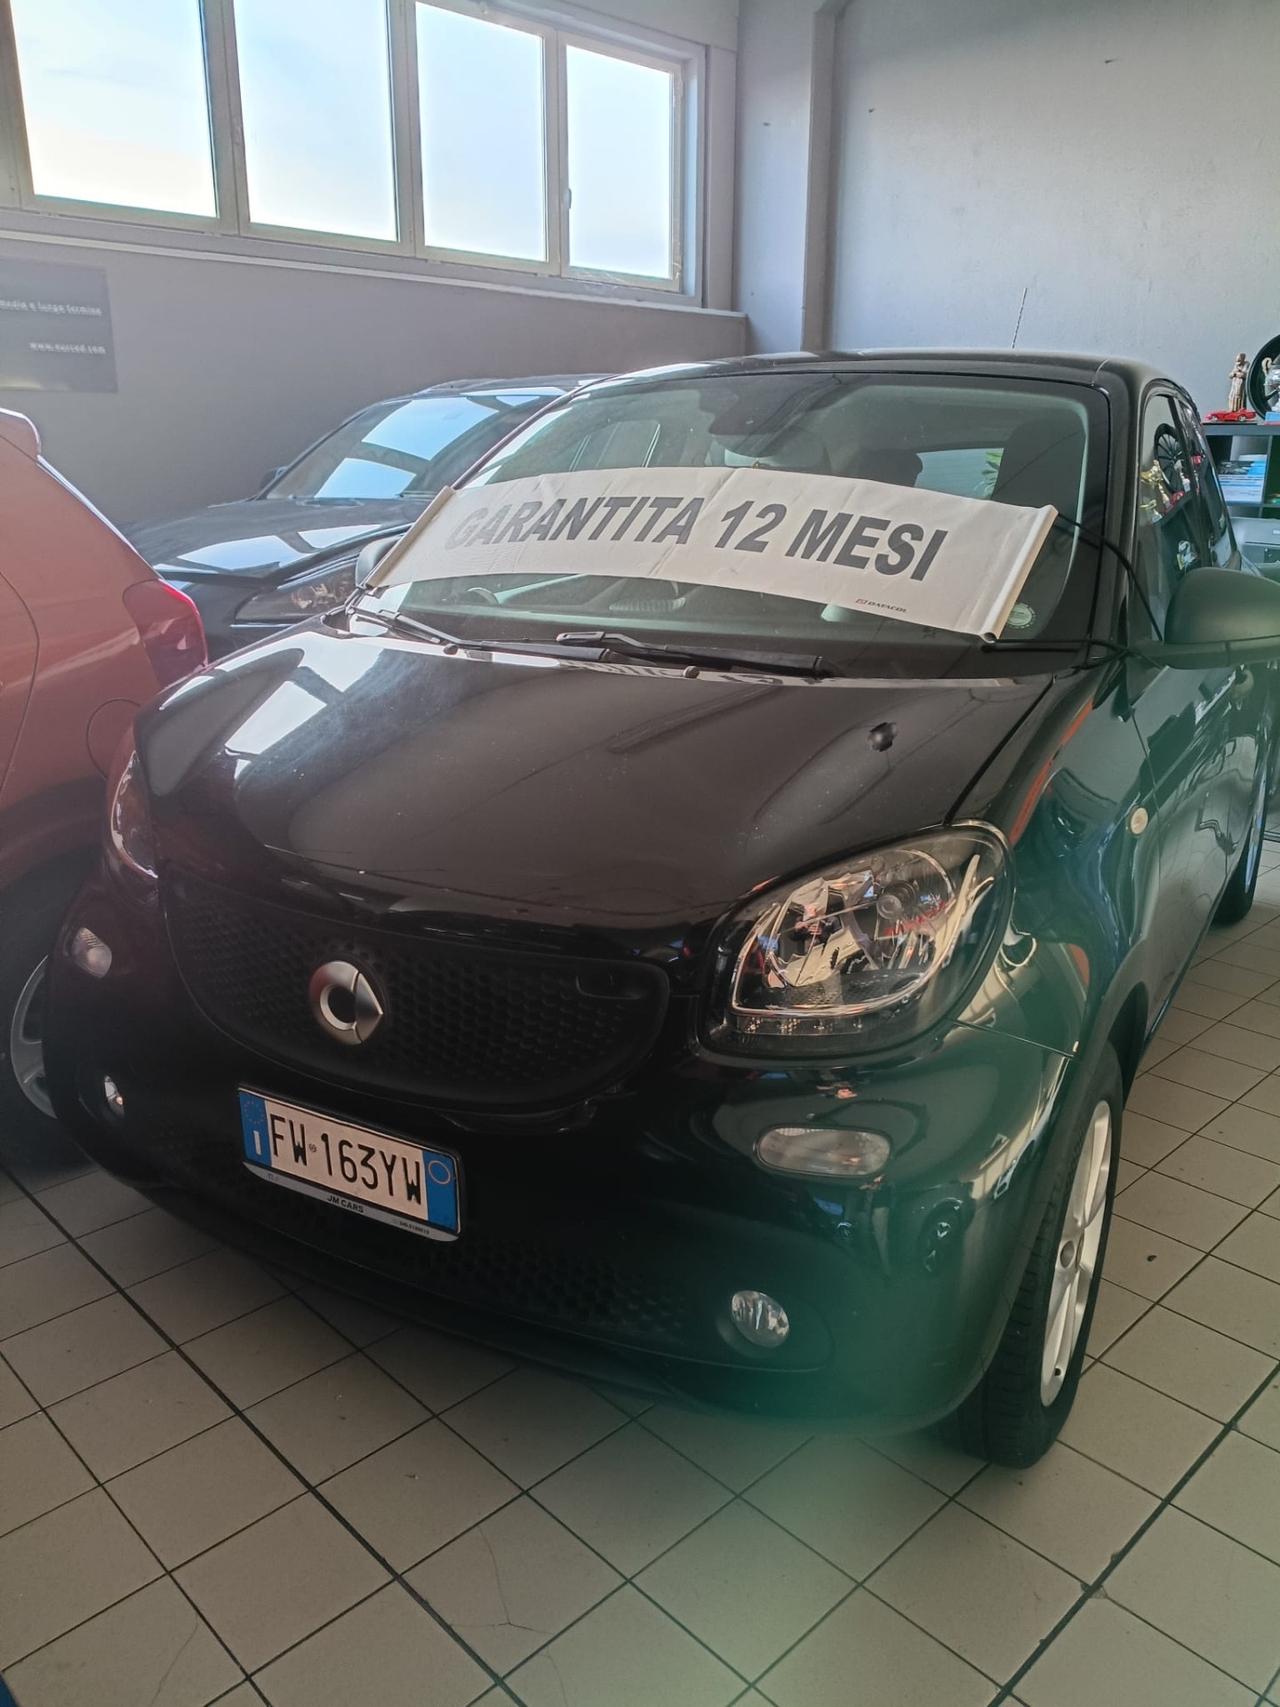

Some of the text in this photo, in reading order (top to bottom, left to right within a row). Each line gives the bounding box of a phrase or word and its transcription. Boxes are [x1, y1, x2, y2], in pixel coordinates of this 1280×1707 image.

[446, 497, 948, 581] GARANTITA 12 MESI
[270, 1114, 421, 1205] FW 163YW
[327, 1195, 365, 1214] JM CARS
